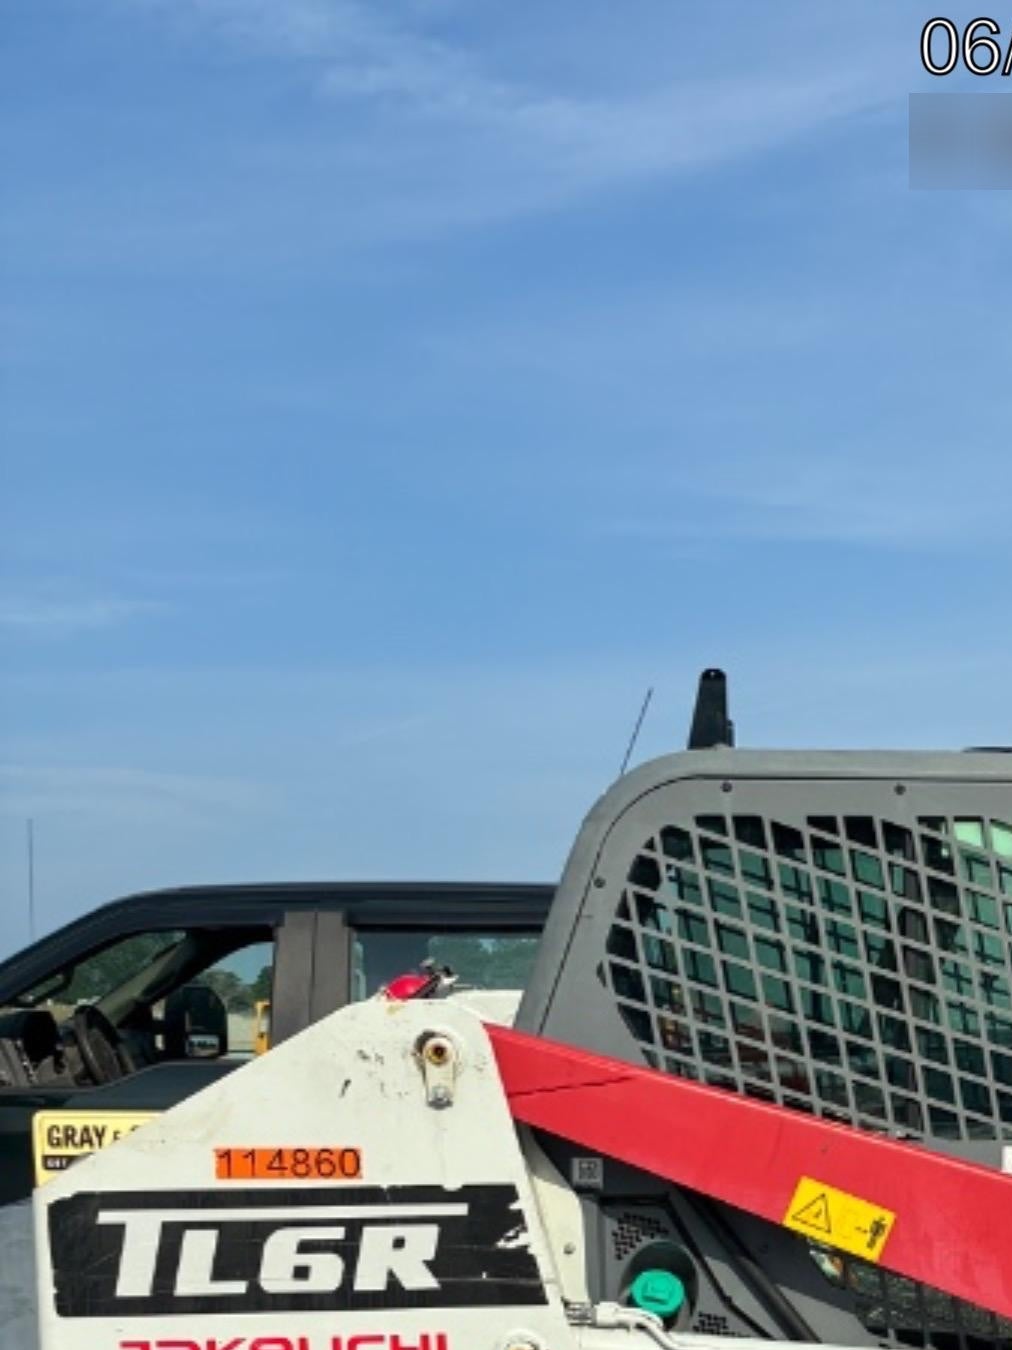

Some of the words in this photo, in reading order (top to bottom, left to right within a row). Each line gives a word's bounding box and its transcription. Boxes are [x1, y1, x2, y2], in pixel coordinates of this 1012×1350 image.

[46, 1124, 107, 1149] GRAY
[217, 1147, 362, 1178] 114860
[96, 1203, 469, 1297] TL6R
